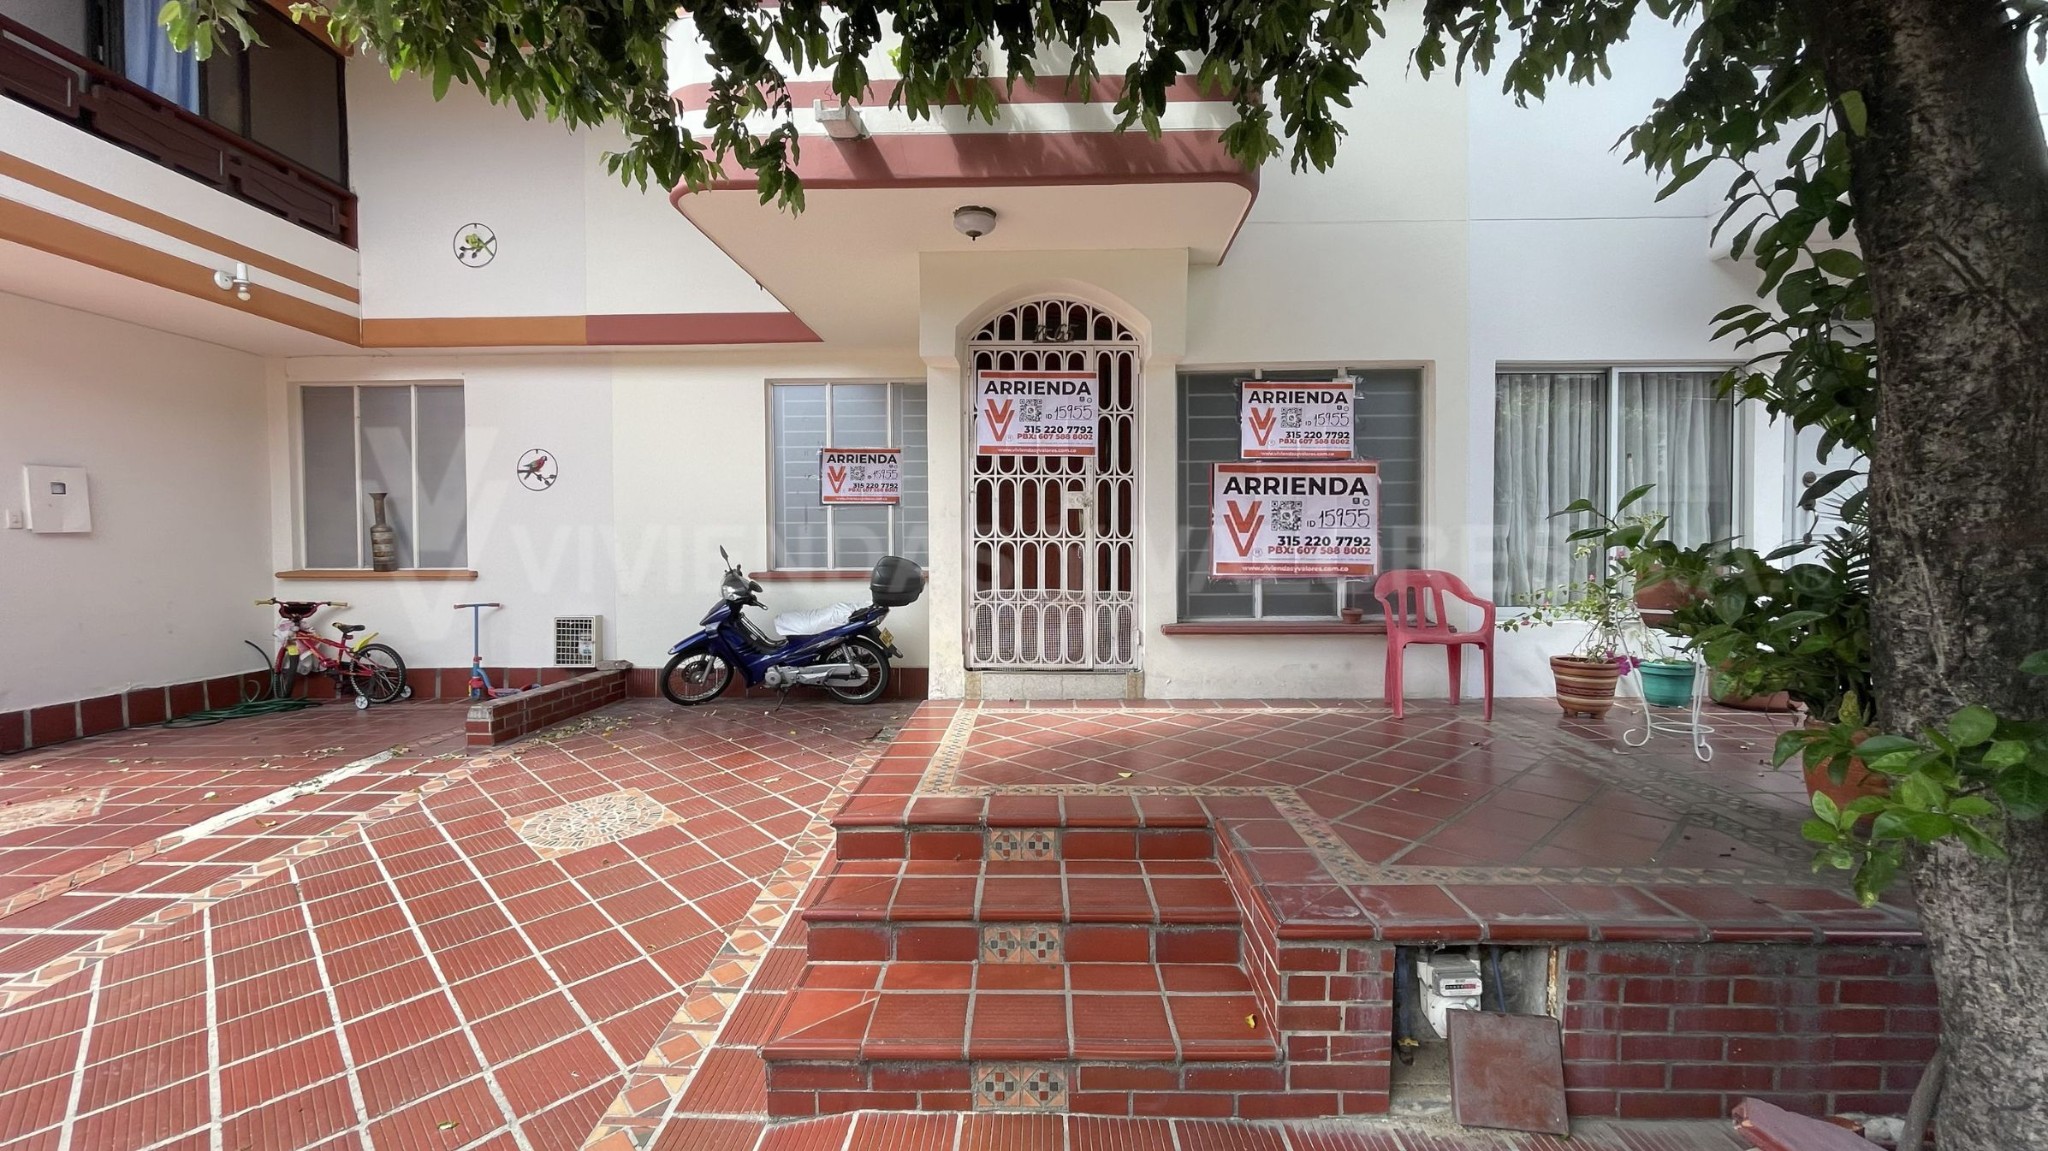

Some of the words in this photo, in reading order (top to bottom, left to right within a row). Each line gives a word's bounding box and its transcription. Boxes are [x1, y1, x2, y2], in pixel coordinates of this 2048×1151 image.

[984, 381, 1091, 395] ARRIENDA
[1248, 391, 1348, 404] ARRIENDA
[1054, 405, 1092, 420] 15955
[1314, 413, 1350, 427] 15955
[1024, 425, 1041, 433] 315
[1067, 426, 1093, 434] 7792
[827, 454, 897, 464] ARRIENDA
[1223, 476, 1369, 496] ARRIENDA
[1318, 508, 1370, 528] 15955
[1278, 536, 1300, 546] 315
[1305, 536, 1331, 546] 220
[1336, 536, 1371, 547] 7792
[1268, 546, 1294, 554] PBX:
[1297, 546, 1317, 554] 607
[1320, 546, 1340, 555] 588
[1343, 547, 1371, 555] 8002
